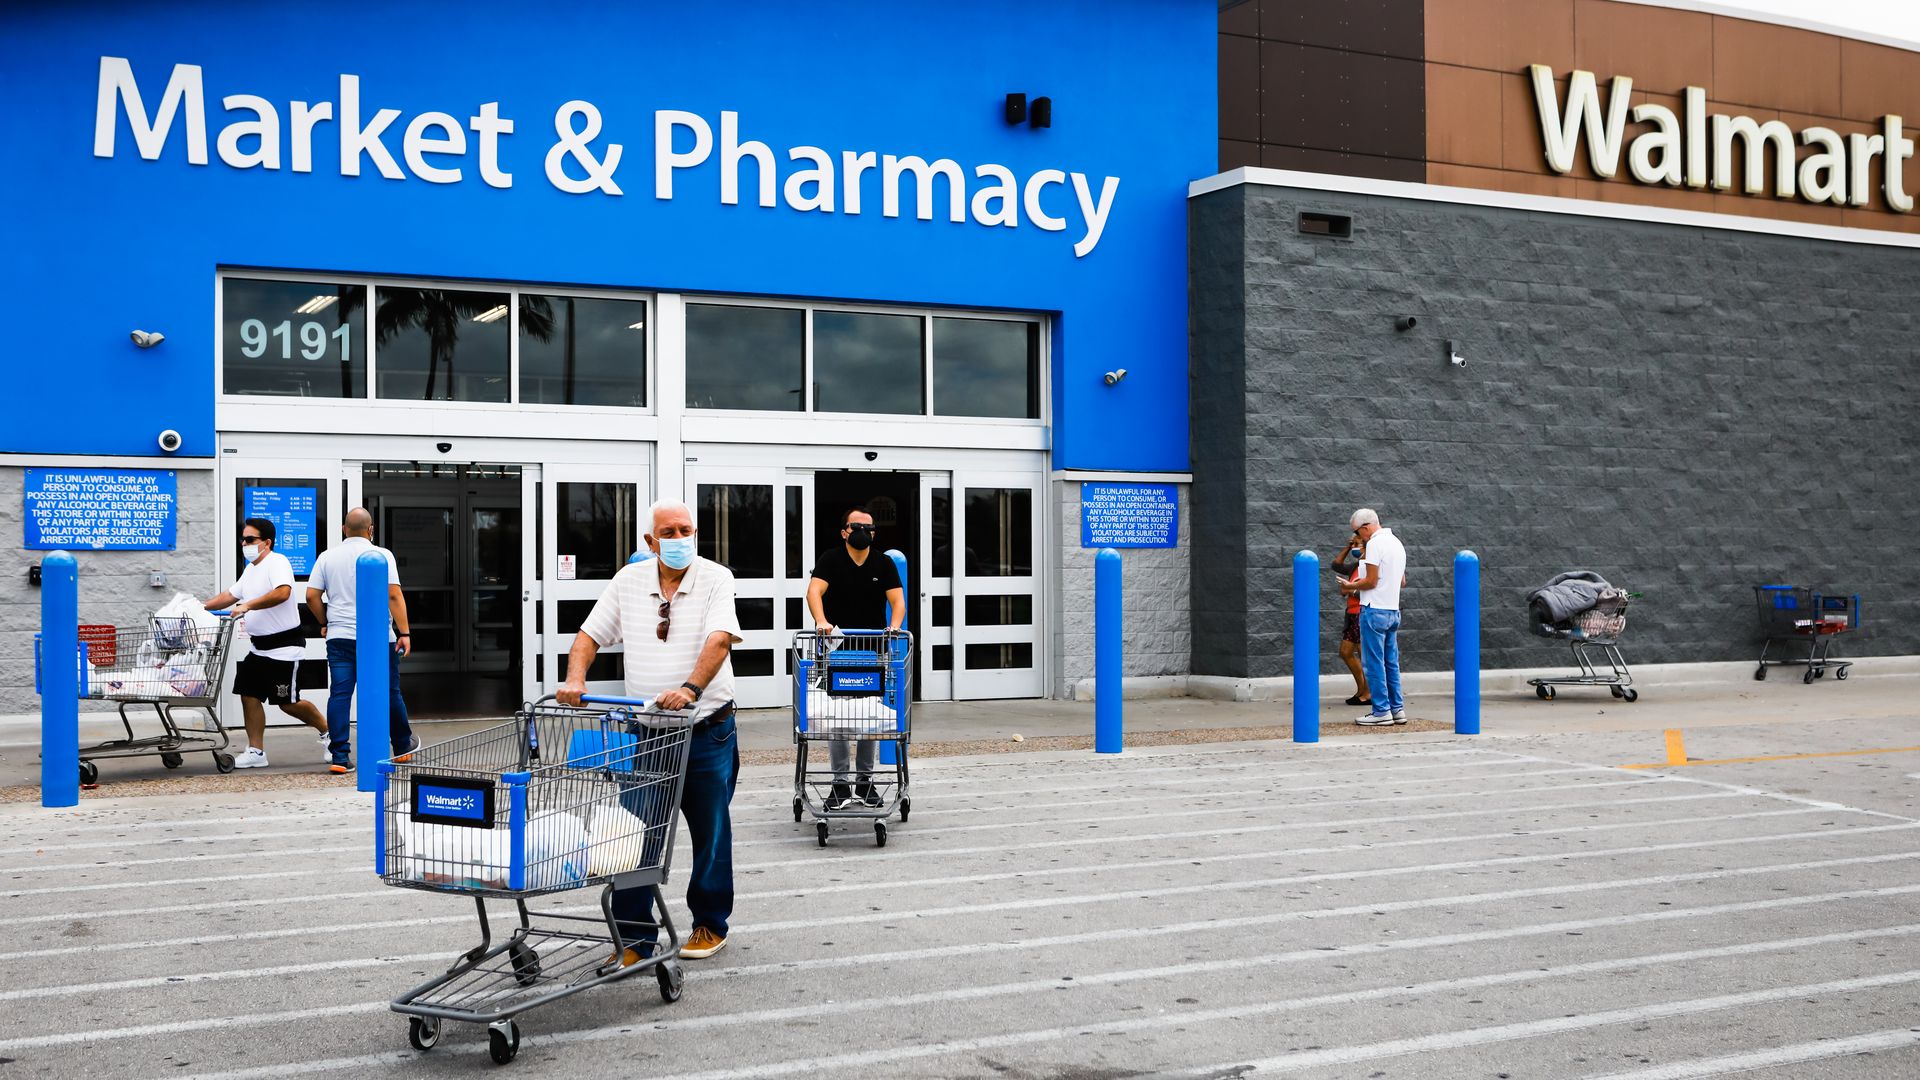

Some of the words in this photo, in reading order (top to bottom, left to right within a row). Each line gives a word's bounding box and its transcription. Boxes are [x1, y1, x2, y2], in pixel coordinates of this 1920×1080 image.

[1530, 63, 1914, 212] Walmart
[94, 57, 513, 187] Market
[545, 100, 623, 194] &
[656, 110, 1119, 257] Pharmacy
[240, 318, 350, 361] 9191
[46, 474, 54, 482] IT
[65, 475, 116, 484] UNLAWFUL
[118, 476, 135, 484] FOR
[137, 476, 156, 484] ANY
[96, 484, 143, 493] CONSUME,
[145, 485, 158, 493] OR
[27, 492, 67, 500] POSSESS
[95, 493, 118, 501] OPEN
[121, 494, 173, 502] CONTAINER,
[58, 501, 110, 509] ALCOHOLIC
[111, 502, 156, 510] BEVERAGE
[54, 510, 82, 518] STORE
[85, 510, 97, 518] OR
[149, 511, 169, 519] FEET
[38, 518, 50, 526] OF
[52, 518, 70, 526] ANY
[40, 527, 90, 535] VIOLATORS
[111, 528, 149, 536] SUBJECT
[150, 528, 161, 536] TO
[76, 536, 96, 544] AND
[97, 536, 161, 544] PROSECUTION.
[427, 795, 461, 806] Walmart
